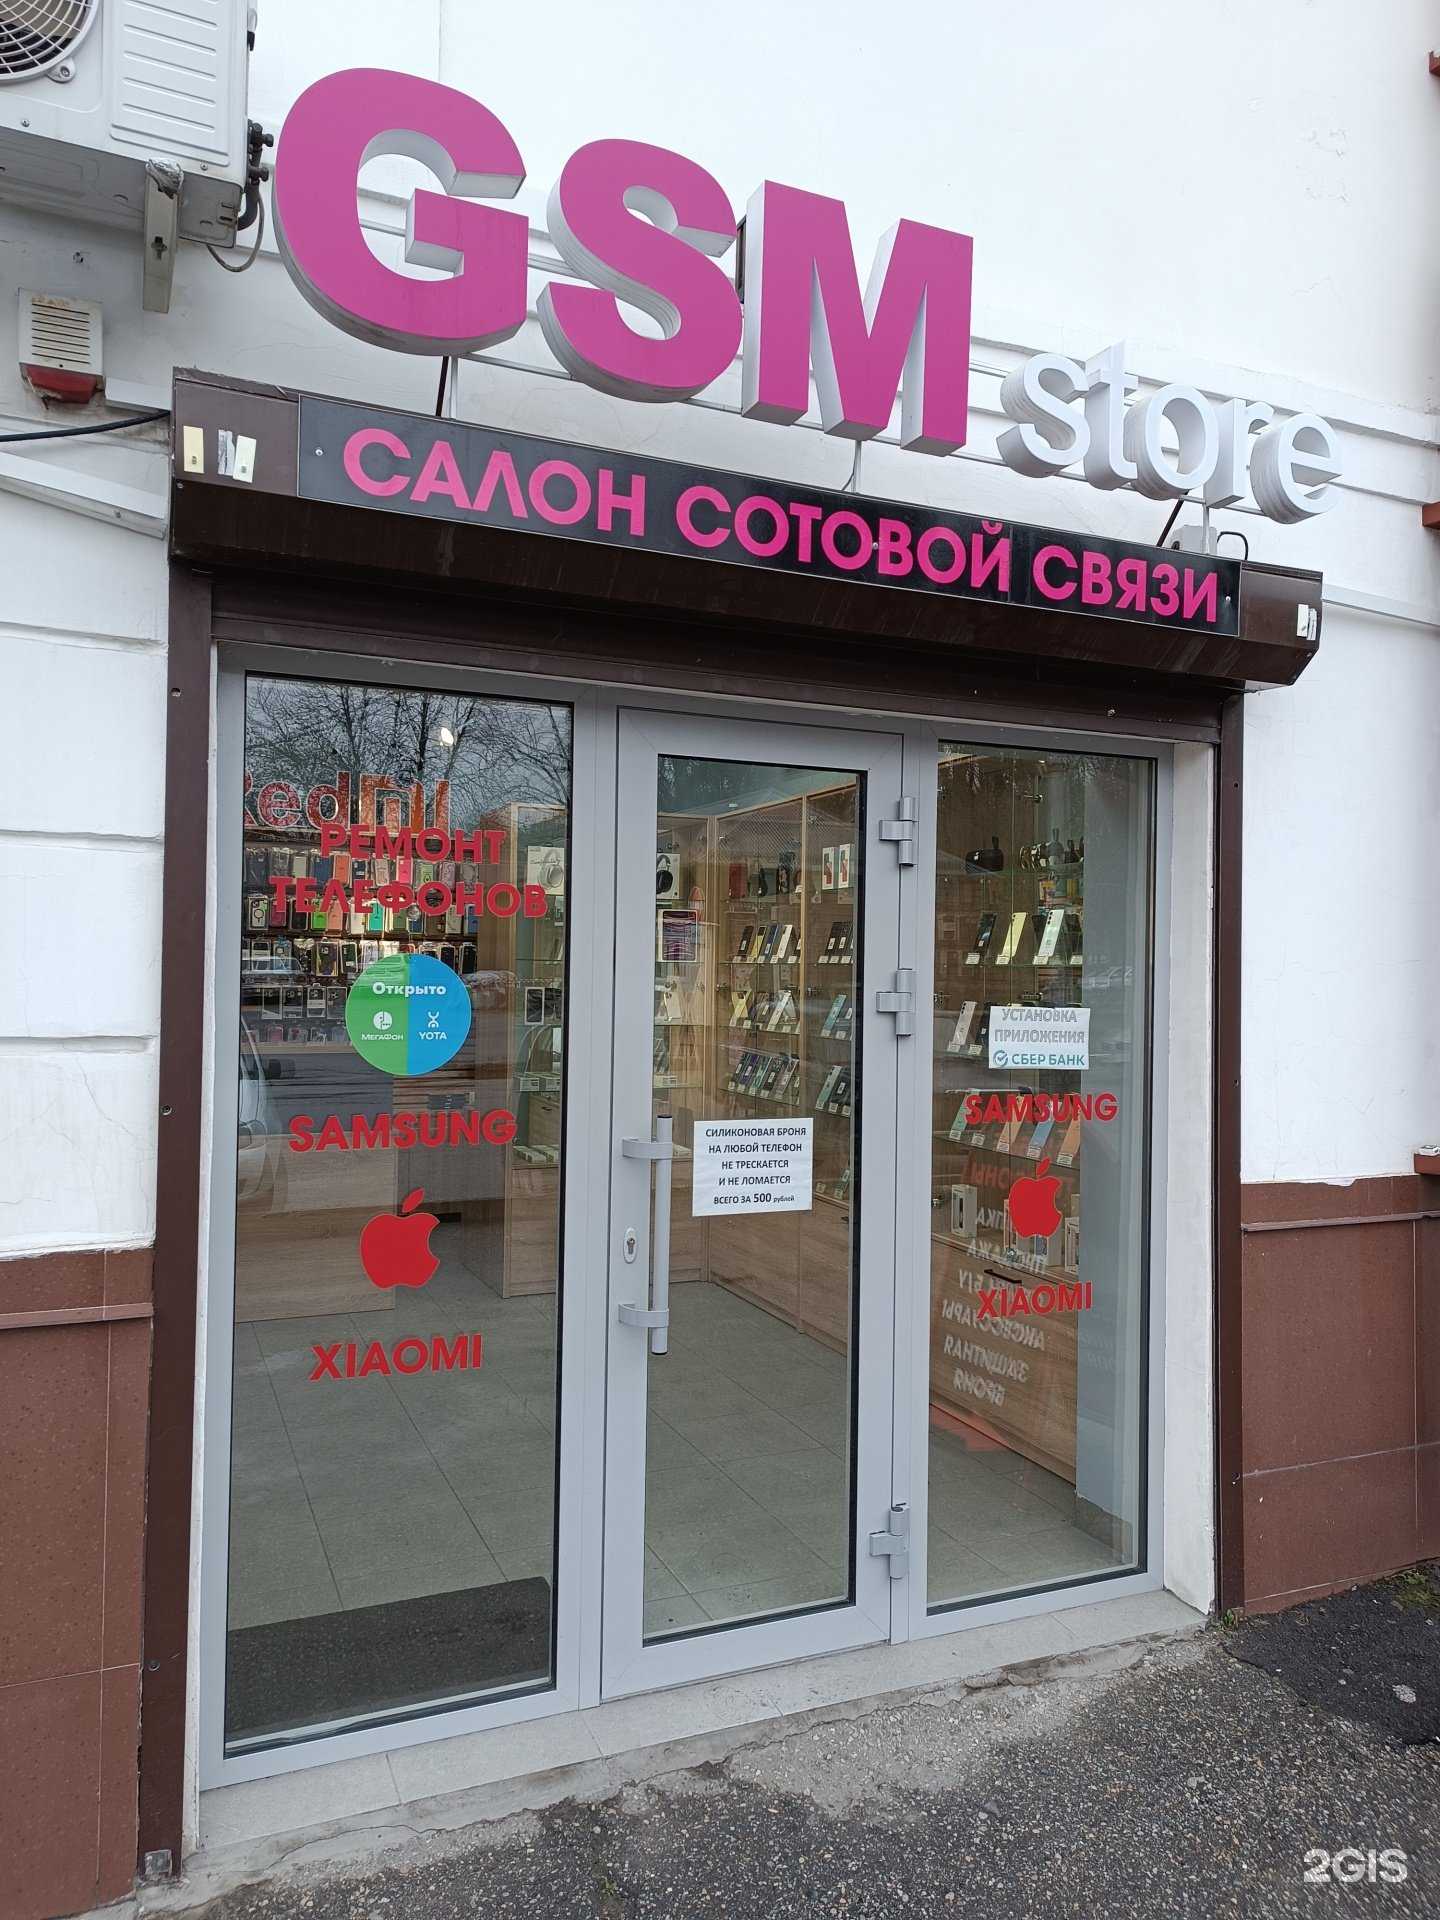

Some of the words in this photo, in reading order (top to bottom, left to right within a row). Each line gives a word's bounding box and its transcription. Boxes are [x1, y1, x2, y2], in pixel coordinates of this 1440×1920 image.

[273, 67, 974, 457] GSM
[996, 339, 1344, 526] store
[343, 427, 646, 538] САЛОН
[675, 486, 1011, 593] СОТОВОЙ
[1032, 545, 1219, 623] СВЯЗИ
[244, 770, 451, 836] edmi
[320, 822, 507, 865] РЕМОНТ
[268, 876, 549, 919] ТЕЛЕФОНОВ
[372, 981, 447, 998] Открыто
[1001, 1008, 1078, 1023] УСТАНОВКА
[419, 1031, 448, 1041] YOTA
[994, 1029, 1085, 1044] ПРИЛОЖЕНИЯ
[1011, 1053, 1046, 1066] СБЕР
[1048, 1054, 1085, 1066] БАНК
[965, 1092, 1118, 1125] SAMSUNG
[288, 1108, 518, 1153] SAMSUNG
[705, 1128, 775, 1137] СИЛИКОНОВАЯ
[777, 1128, 806, 1136] БРОНЯ
[708, 1145, 722, 1154] НА
[723, 1142, 759, 1153] ЛЮБОЙ
[761, 1143, 802, 1152] ТЕЛЕФОН
[721, 1161, 733, 1170] НЕ
[736, 1160, 788, 1169] ТРЕСКАЕТСЯ
[718, 1177, 726, 1186] И
[727, 1177, 740, 1186] НЕ
[741, 1176, 790, 1185] ЛОМАЕТСЯ
[713, 1196, 739, 1205] ВСЕГО
[741, 1195, 752, 1204] ЗА
[753, 1192, 772, 1203] 500
[773, 1195, 794, 1203] рублей
[976, 1280, 1093, 1320] XIAOMI
[308, 1332, 484, 1383] XIAOMI
